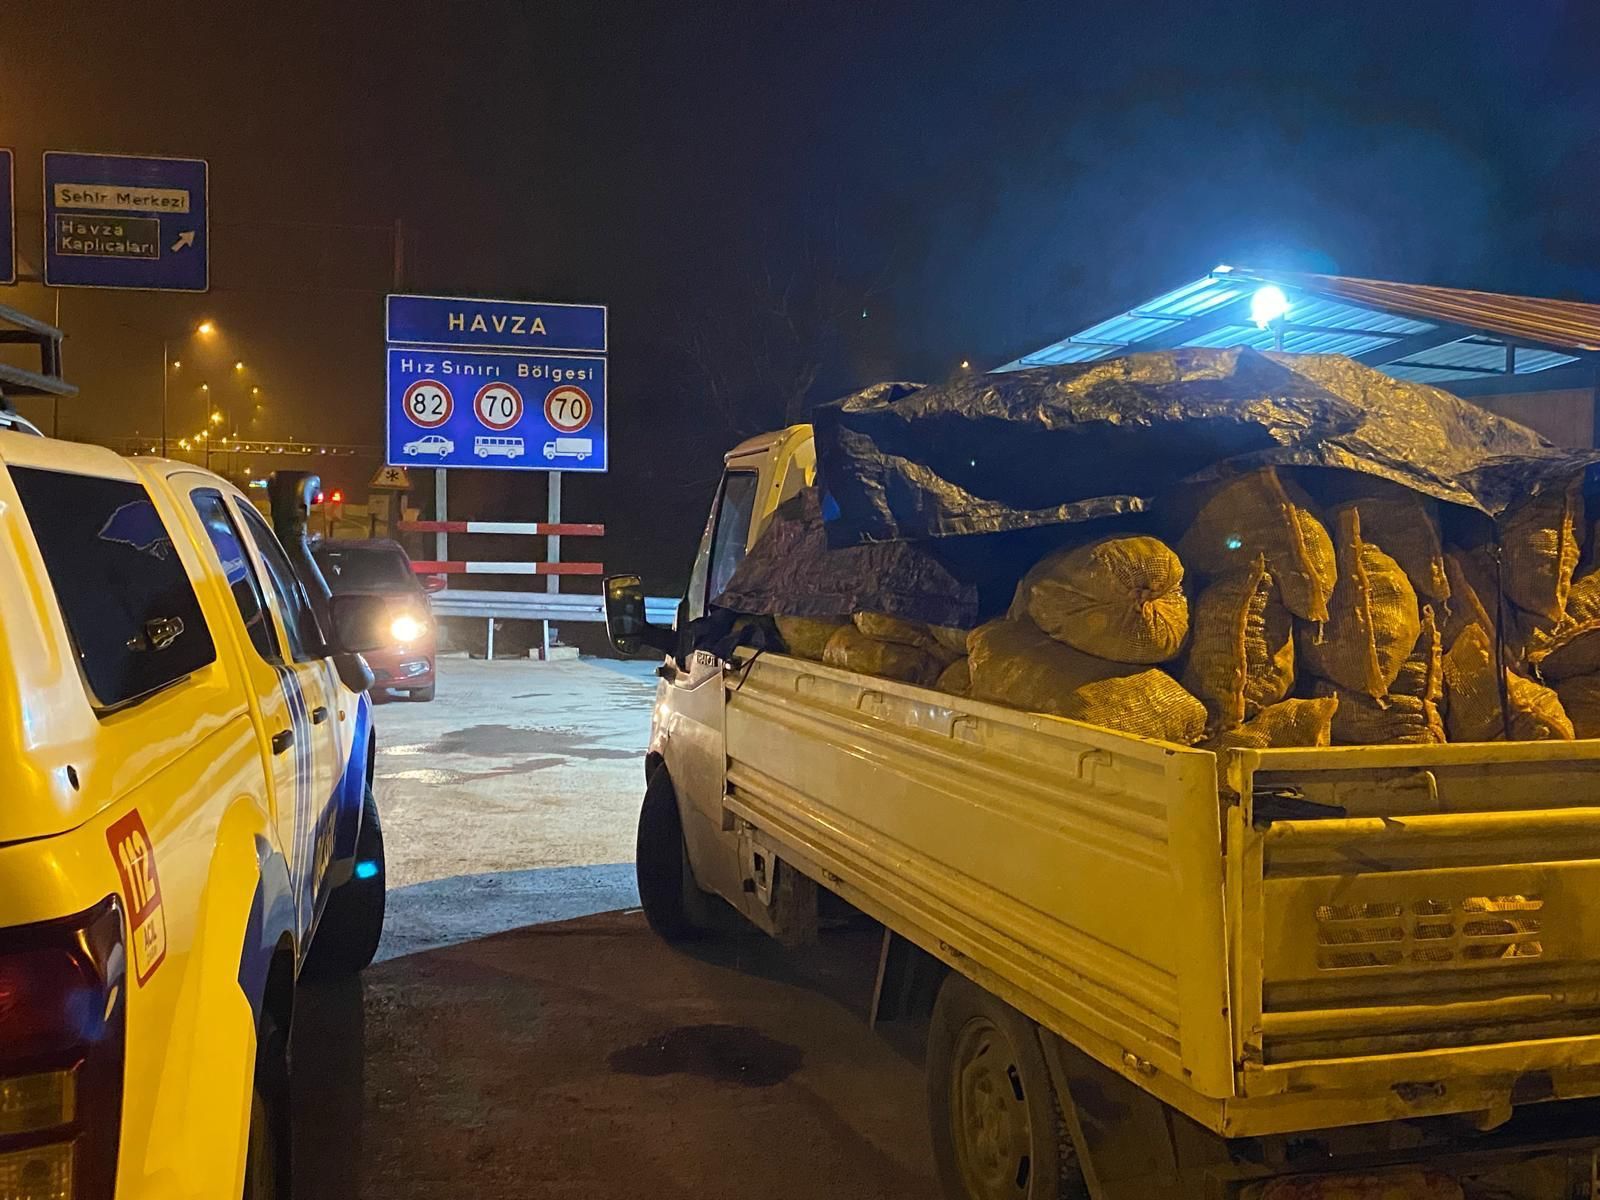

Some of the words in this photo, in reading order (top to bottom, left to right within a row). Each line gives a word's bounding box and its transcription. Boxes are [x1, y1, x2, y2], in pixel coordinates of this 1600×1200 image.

[61, 189, 108, 204] Şehir
[116, 193, 186, 208] Merkezi
[61, 220, 124, 235] Havza
[61, 237, 154, 254] Kaplıcaları
[448, 312, 547, 335] HAVZA
[401, 358, 435, 374] Hız
[442, 361, 500, 376] Sınırı
[517, 363, 593, 382] Bölgesi
[413, 393, 443, 416] 82
[485, 395, 514, 417] 70
[555, 398, 583, 420] 70
[118, 830, 156, 914] 112
